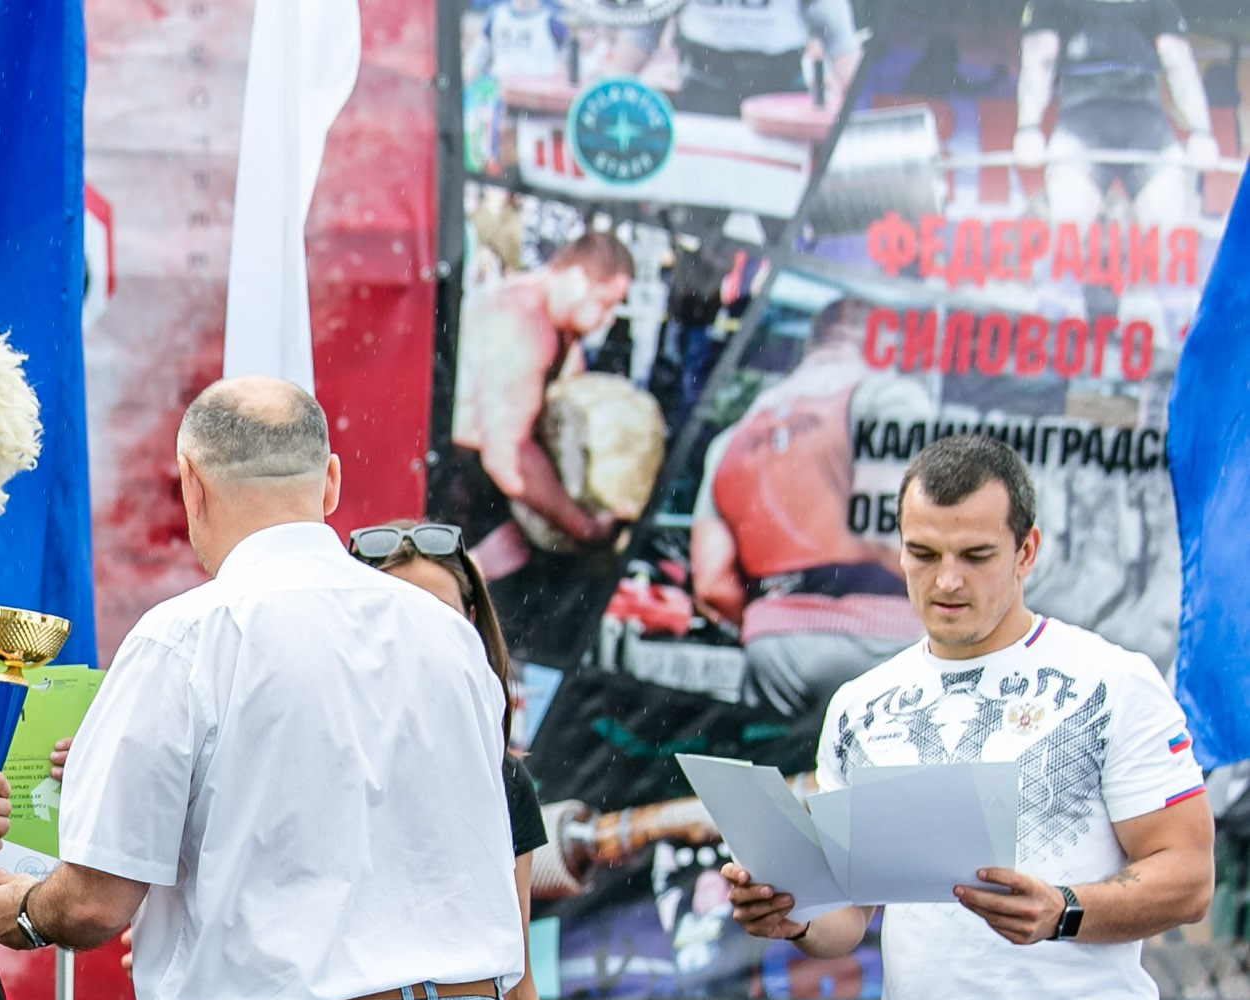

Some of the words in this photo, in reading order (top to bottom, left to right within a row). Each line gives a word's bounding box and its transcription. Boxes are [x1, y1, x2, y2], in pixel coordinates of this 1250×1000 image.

[866, 210, 1200, 297] ФЕДЕРАЦИЯ
[861, 307, 1154, 381] СИЛОВОГО
[853, 418, 1170, 475] КАЛНГРАДС
